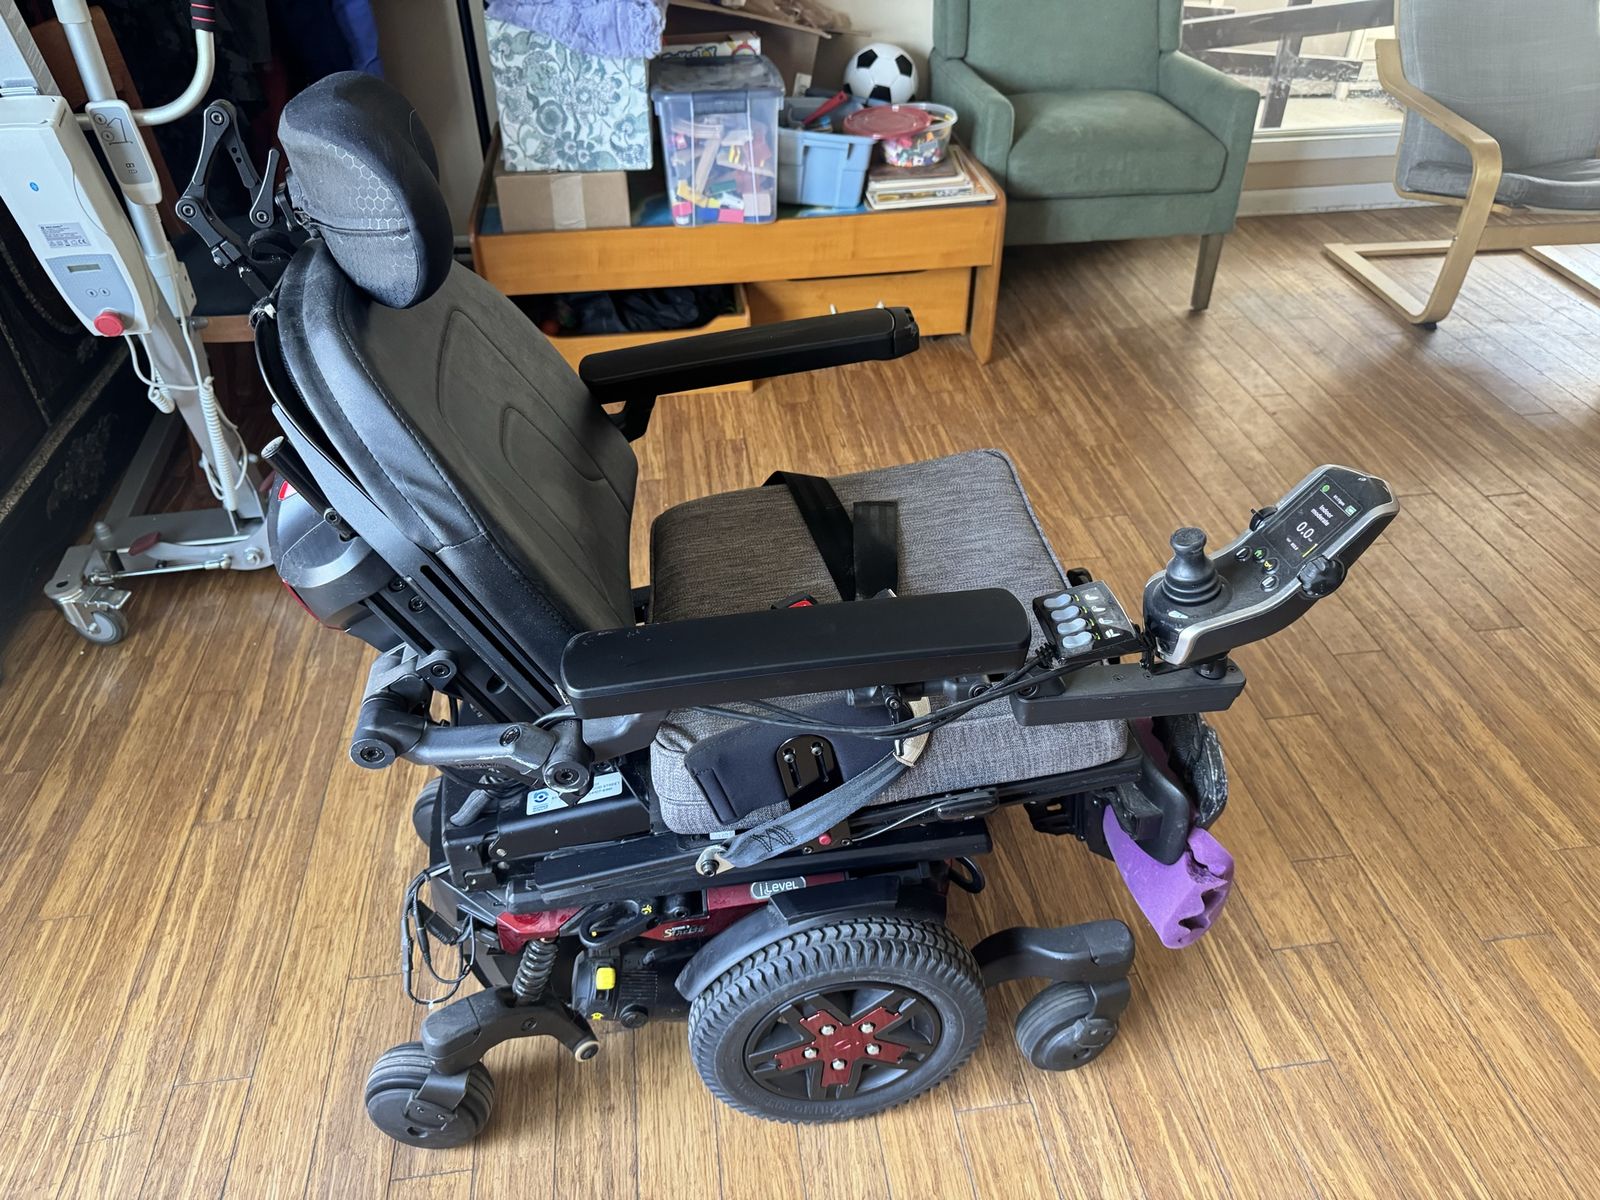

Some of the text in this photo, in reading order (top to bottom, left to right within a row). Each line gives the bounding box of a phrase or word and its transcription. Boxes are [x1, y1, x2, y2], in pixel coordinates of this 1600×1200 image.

[1311, 508, 1330, 526] moderate
[1319, 504, 1333, 518] Indoor
[1296, 521, 1314, 539] 0.0
